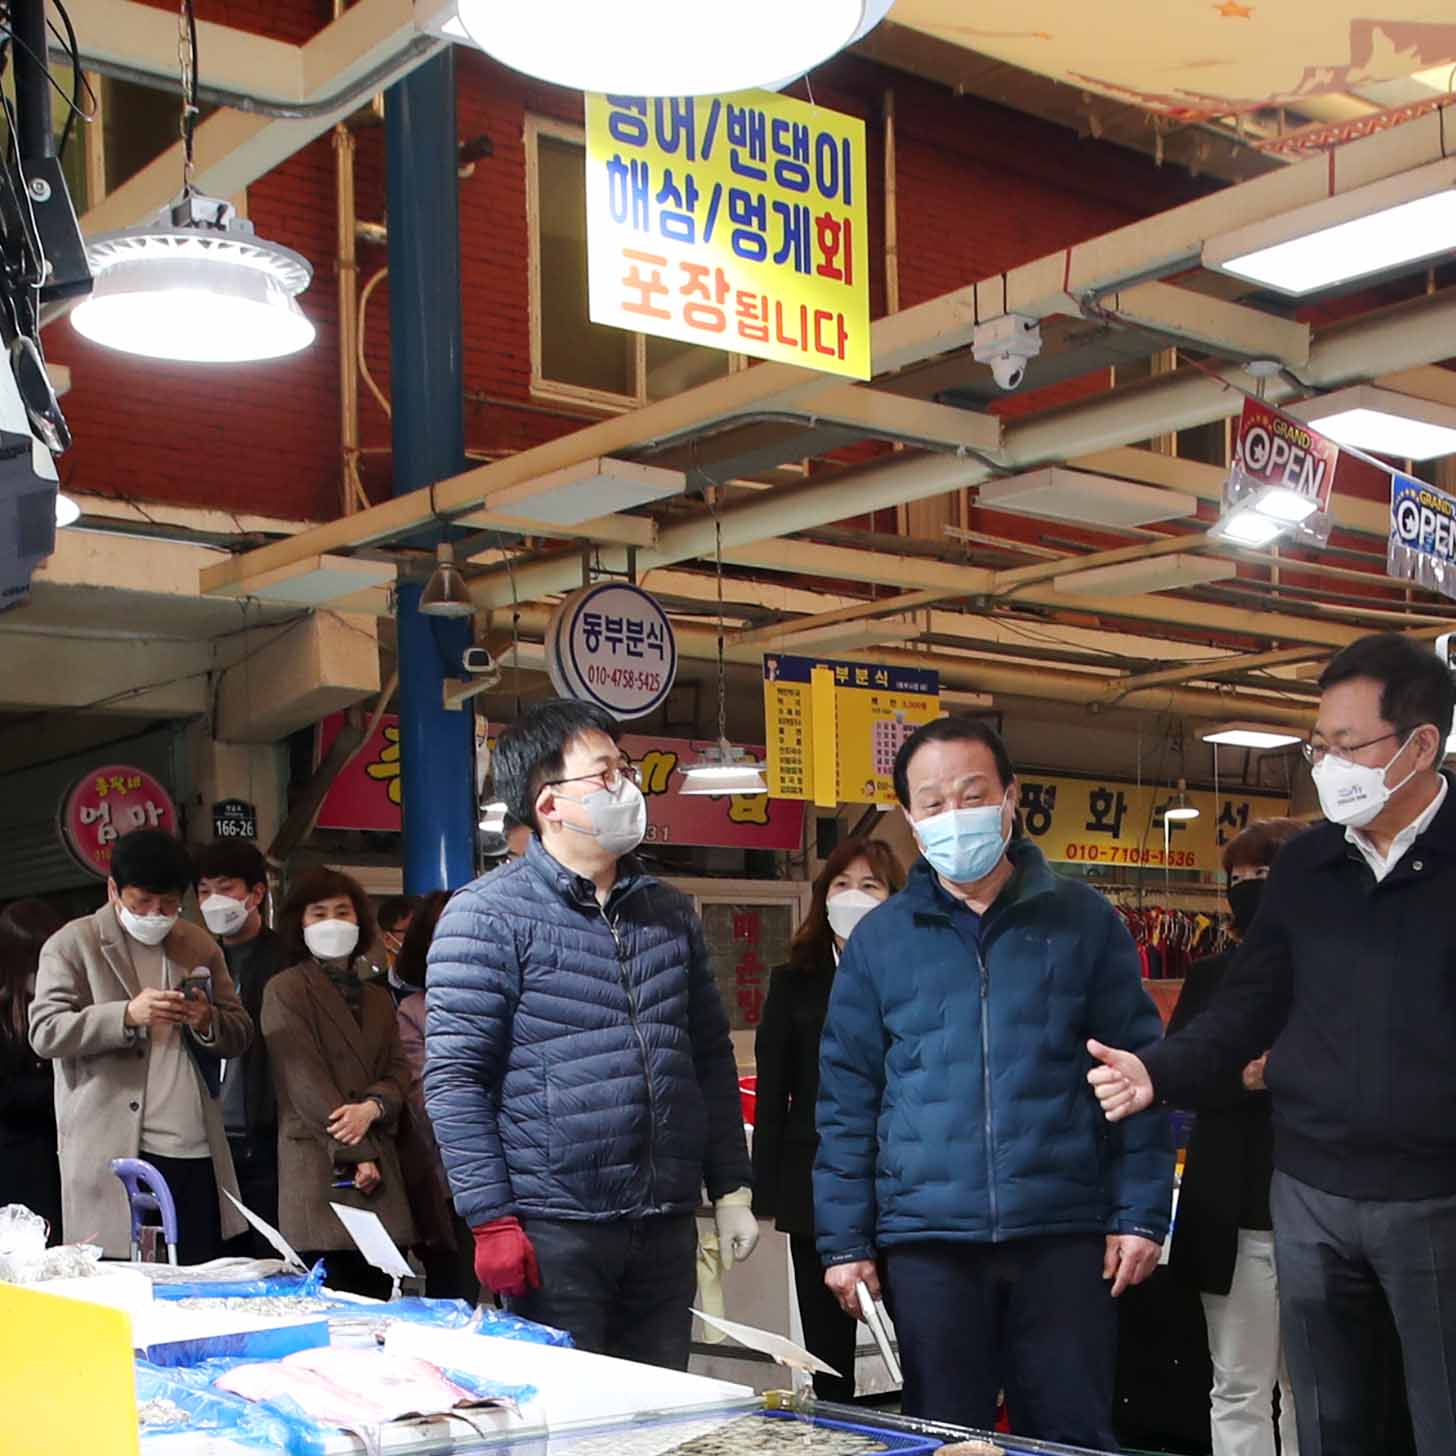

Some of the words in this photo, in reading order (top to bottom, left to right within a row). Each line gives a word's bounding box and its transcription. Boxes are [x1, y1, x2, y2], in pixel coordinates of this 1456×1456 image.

[606, 153, 853, 286] 해삼/멍게회
[621, 246, 849, 361] 포장됩니다
[1272, 417, 1313, 449] GRAND
[1244, 426, 1327, 501] OPEN
[1417, 490, 1453, 516] GRAND
[583, 612, 664, 662] 동부분식
[588, 664, 661, 692] 010-4758-5425
[216, 819, 254, 838] 166-26
